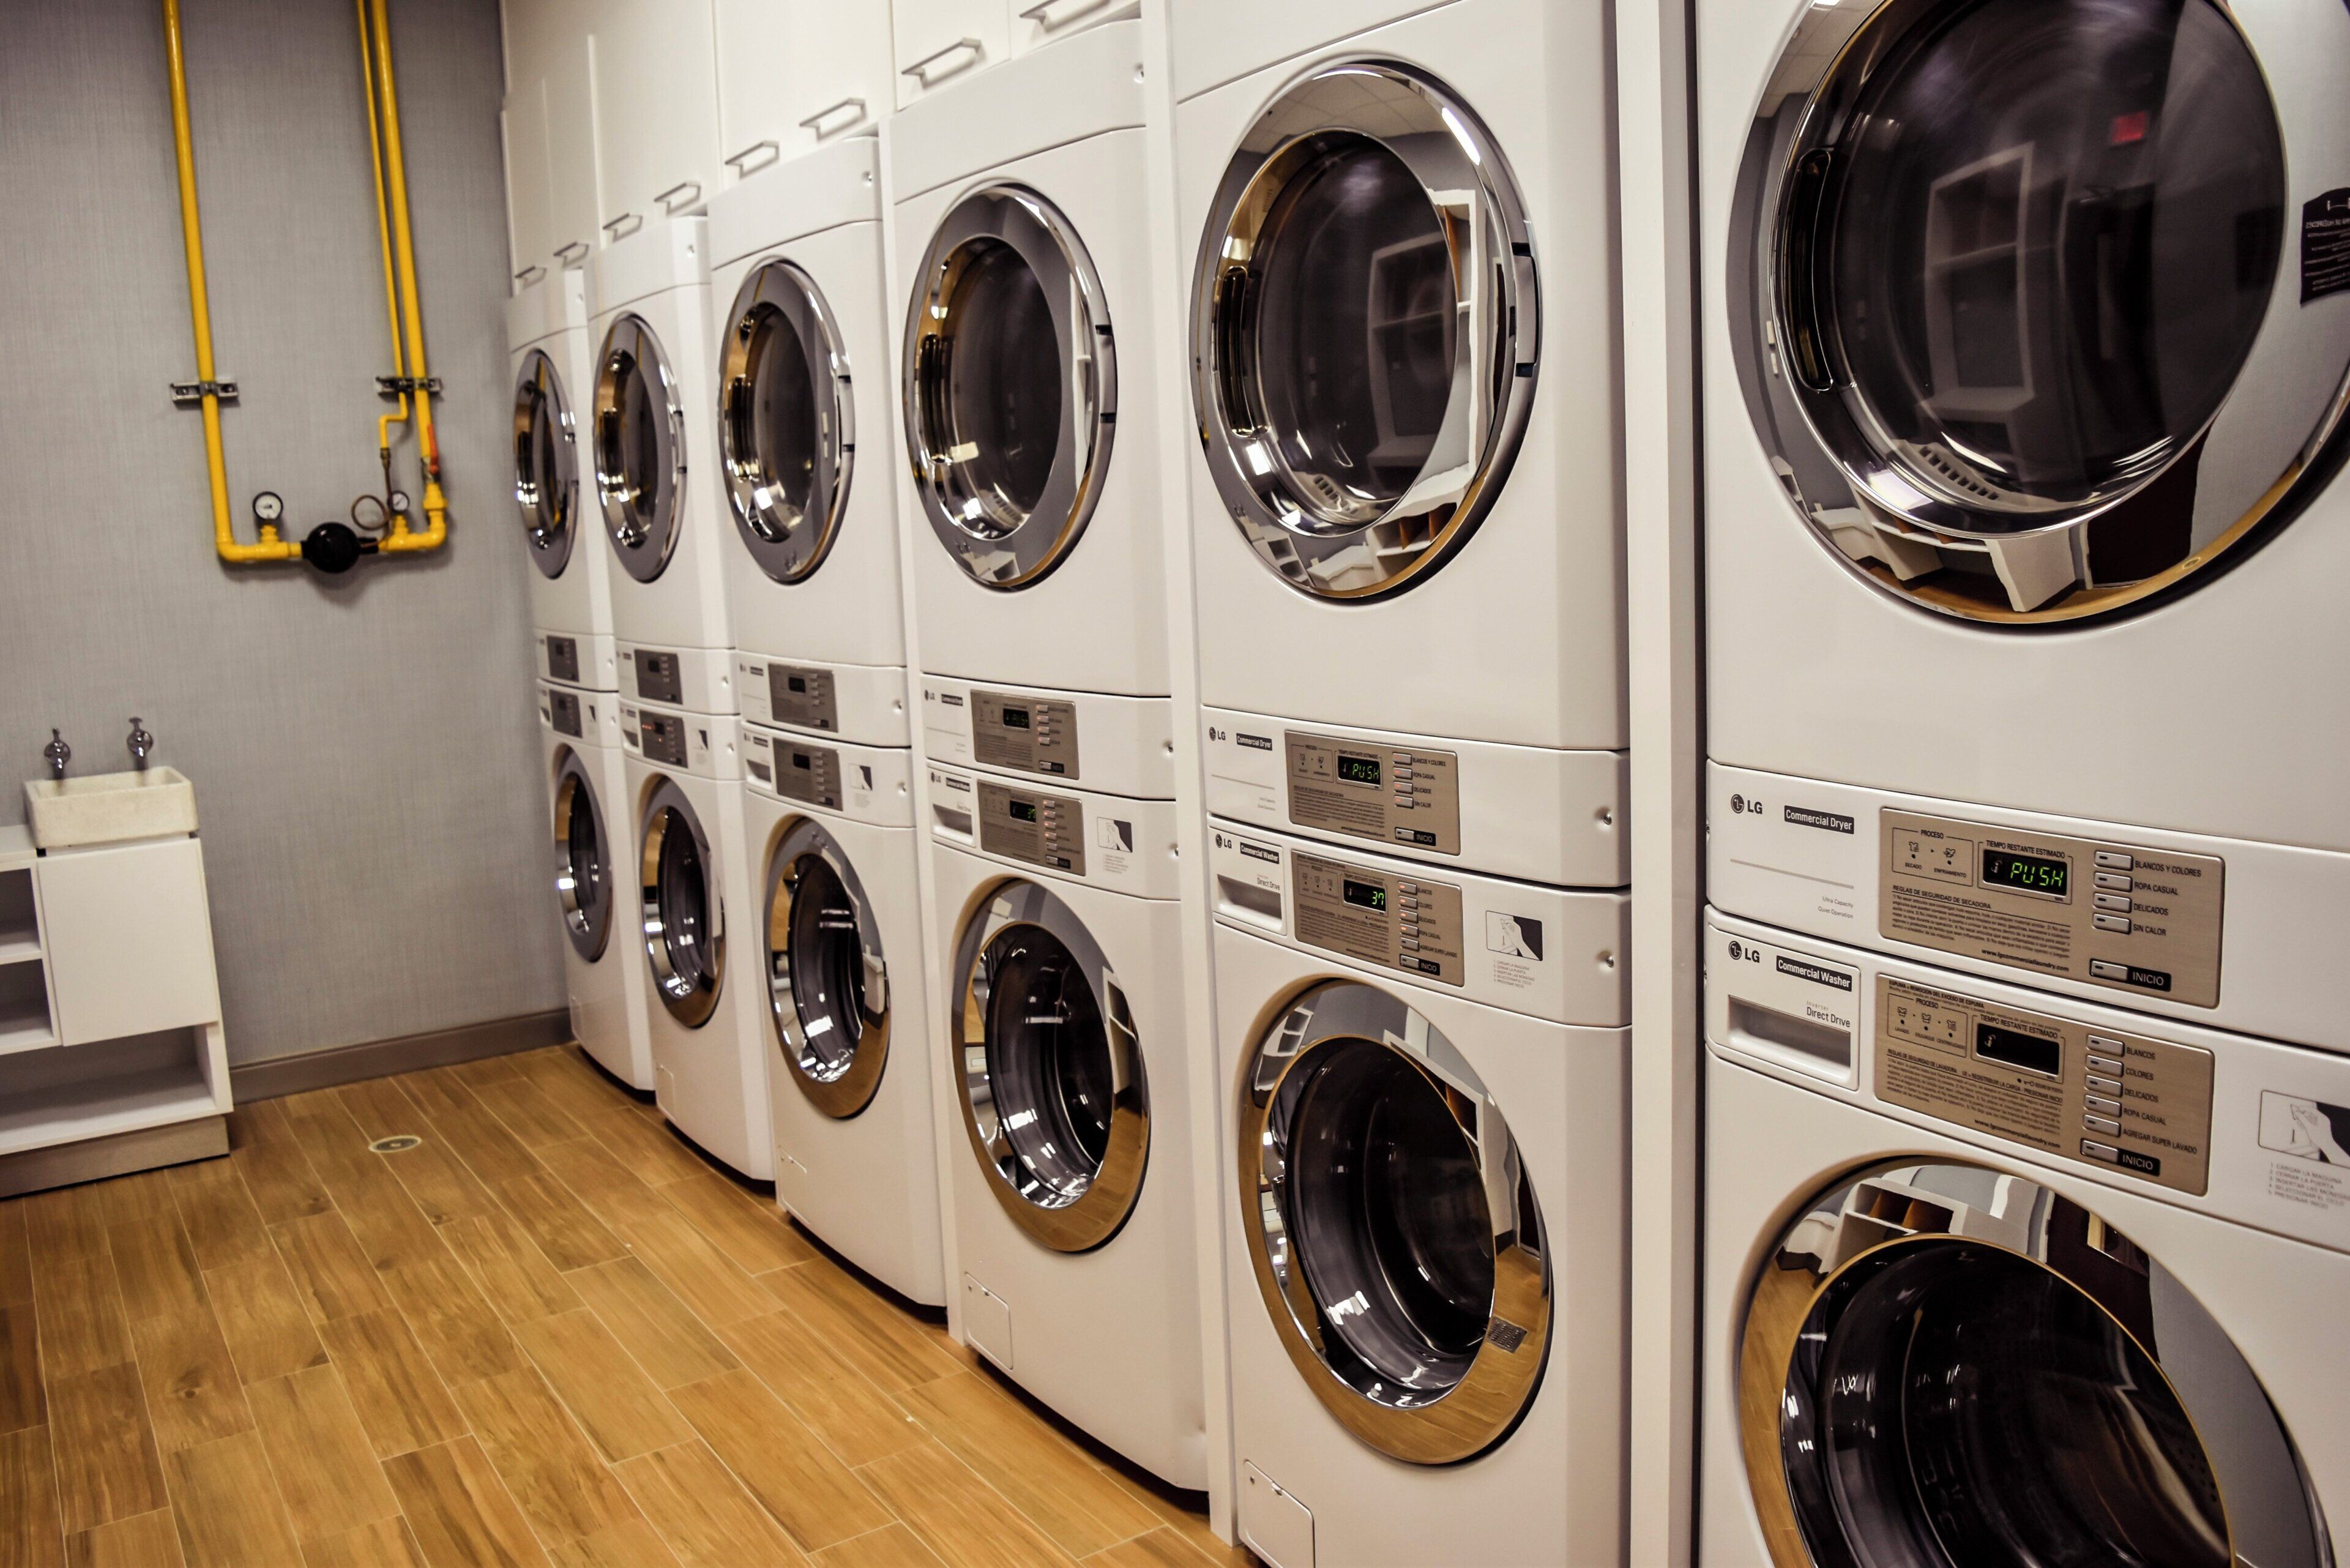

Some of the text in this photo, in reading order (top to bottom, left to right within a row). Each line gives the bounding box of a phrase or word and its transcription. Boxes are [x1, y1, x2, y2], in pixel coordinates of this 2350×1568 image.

[1218, 731, 1226, 741] LG
[1237, 736, 1272, 749] Commercial Dryer
[1352, 764, 1379, 779] PUSH
[1747, 800, 1762, 815] LG
[1786, 809, 1852, 831] Commercial Dryer
[1416, 834, 1433, 843] INICIO
[1920, 829, 1944, 839] PROCESO
[1224, 838, 1232, 849] LG
[1986, 840, 2065, 859] TIEMPO RESTANTE ESTIMADO
[2010, 862, 2064, 887] PUSH
[2135, 861, 2164, 872] BLANCOS
[2172, 866, 2201, 877] COLORES
[2135, 882, 2178, 895] ROPA CASUAL
[1892, 885, 1912, 894] REGLAS
[1922, 890, 1952, 902] SEGURIDAD
[1961, 897, 1991, 909] SECADORA
[2134, 903, 2169, 916] DELICADOS
[2145, 927, 2166, 936] CALOR
[1745, 947, 1760, 963] LG
[1421, 963, 1437, 972] INICIO
[1778, 960, 1851, 988] Commercial Washer
[2133, 972, 2164, 986] INICIO
[1915, 998, 1939, 1009] PROCESO
[1807, 1007, 1851, 1028] Direct Drive
[1980, 1014, 1999, 1025] TIEMPO
[2001, 1018, 2028, 1032] RESTANTE
[2029, 1026, 2058, 1039] ESTIMADO
[2127, 1047, 2155, 1060] BLANCOS
[2125, 1068, 2154, 1081] COLORES
[2125, 1088, 2158, 1103] DELICADOS
[2124, 1108, 2166, 1125] ROPA CASUAL
[2124, 1128, 2197, 1154] AGREGAR SUPER LAVADO
[2122, 1154, 2154, 1170] INICIO
